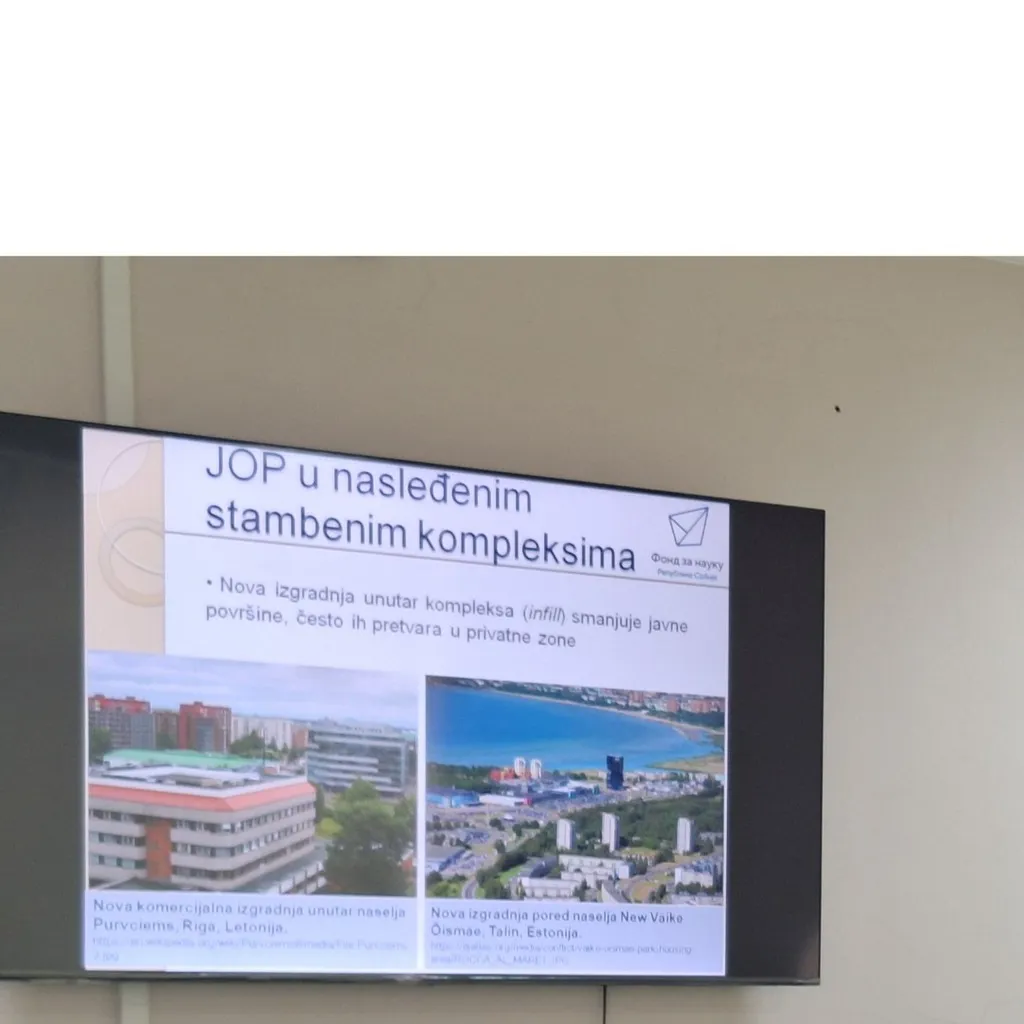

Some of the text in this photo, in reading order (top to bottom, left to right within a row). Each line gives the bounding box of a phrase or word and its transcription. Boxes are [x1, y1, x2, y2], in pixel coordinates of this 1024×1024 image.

[206, 446, 532, 513] JOP u nasleđenim
[206, 501, 636, 573] stambenim kompleksima
[651, 553, 724, 573] Фонд за науку
[220, 576, 689, 634] Nova izgradnja unutar kompleksa (infill) smanjuje javne
[205, 604, 576, 648] površine, često ih pretvara u privatne zone
[93, 899, 406, 921] Nova komercijalna izgradnja unutar naselja
[431, 906, 684, 925] Nova izgradnja pored naselja New Vaike
[225, 920, 288, 936] Letonija.
[527, 926, 582, 941] Estonija.
